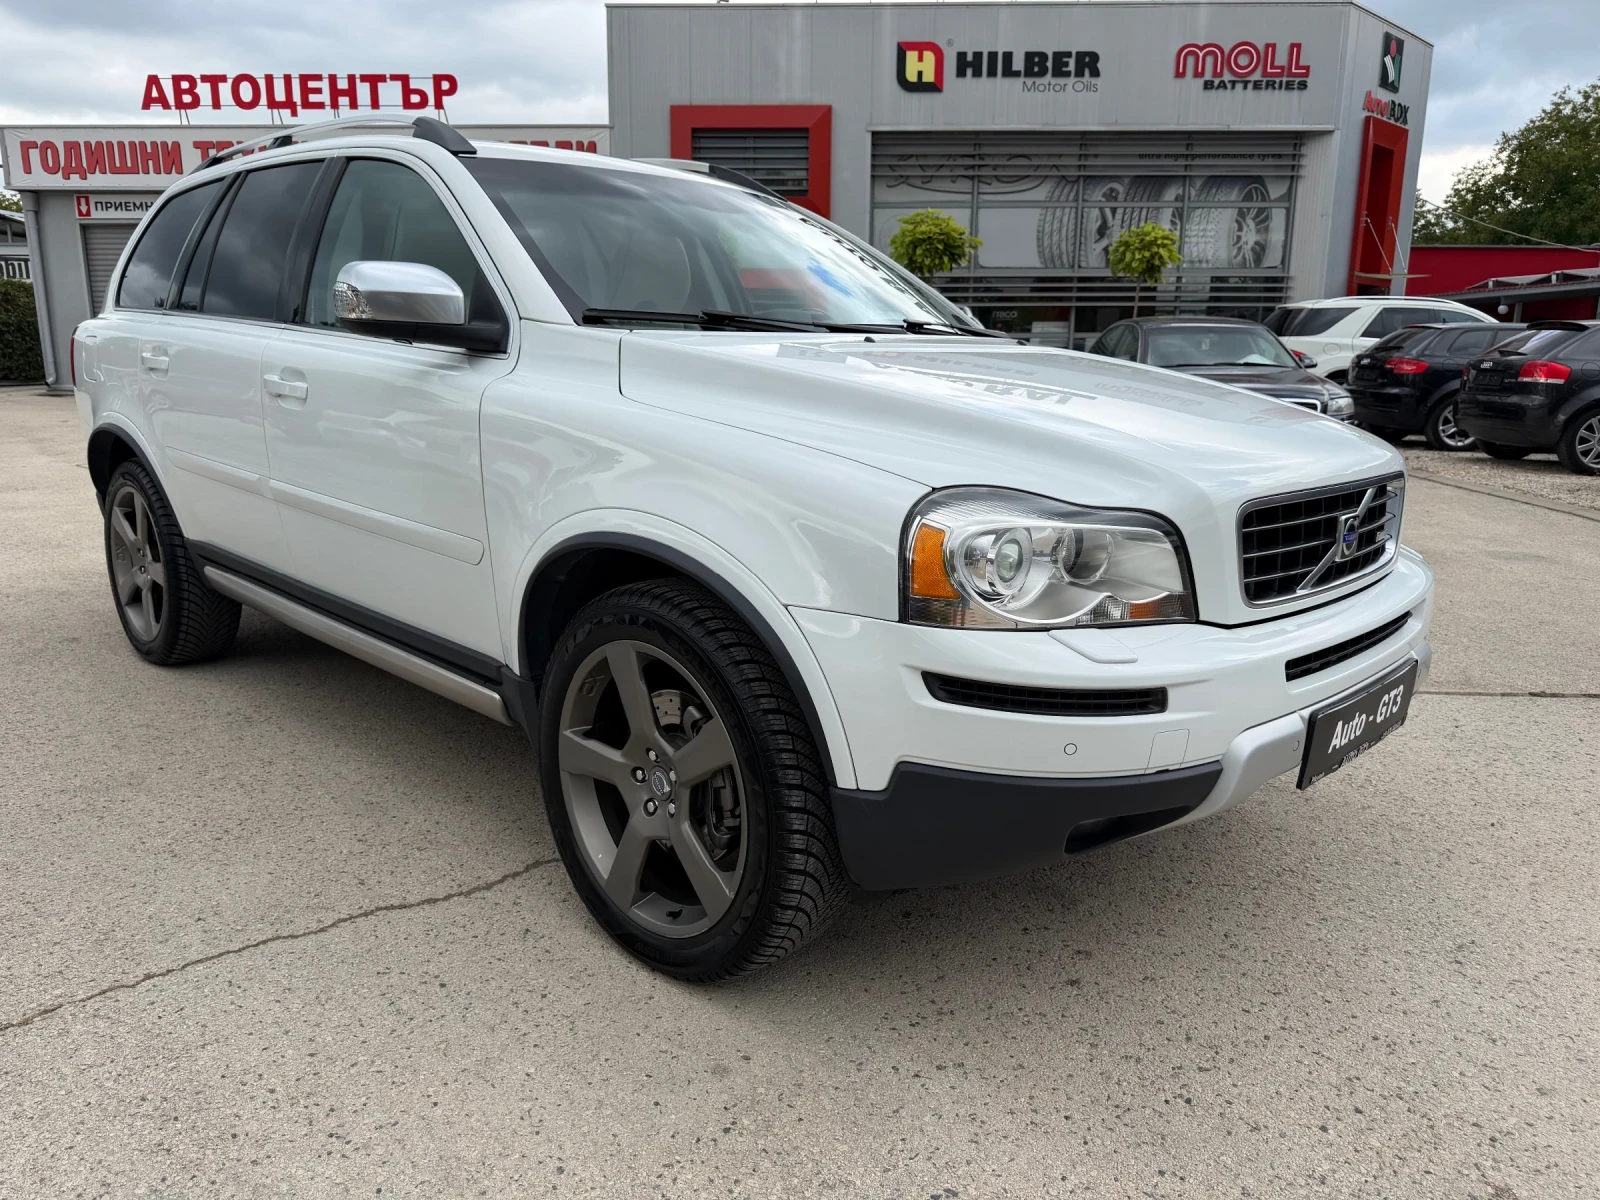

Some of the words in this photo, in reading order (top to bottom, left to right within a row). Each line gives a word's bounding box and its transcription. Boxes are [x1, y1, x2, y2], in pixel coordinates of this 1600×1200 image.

[956, 50, 1101, 78] HILBER
[140, 73, 458, 117] АВТОЦЕНТЪР
[1022, 80, 1069, 93] Motor
[1072, 80, 1099, 93] Oils
[1203, 80, 1308, 91] BATTERIES
[19, 139, 184, 180] ГОДИШНИ
[1328, 711, 1367, 754] Auto
[1376, 684, 1405, 724] GT3
